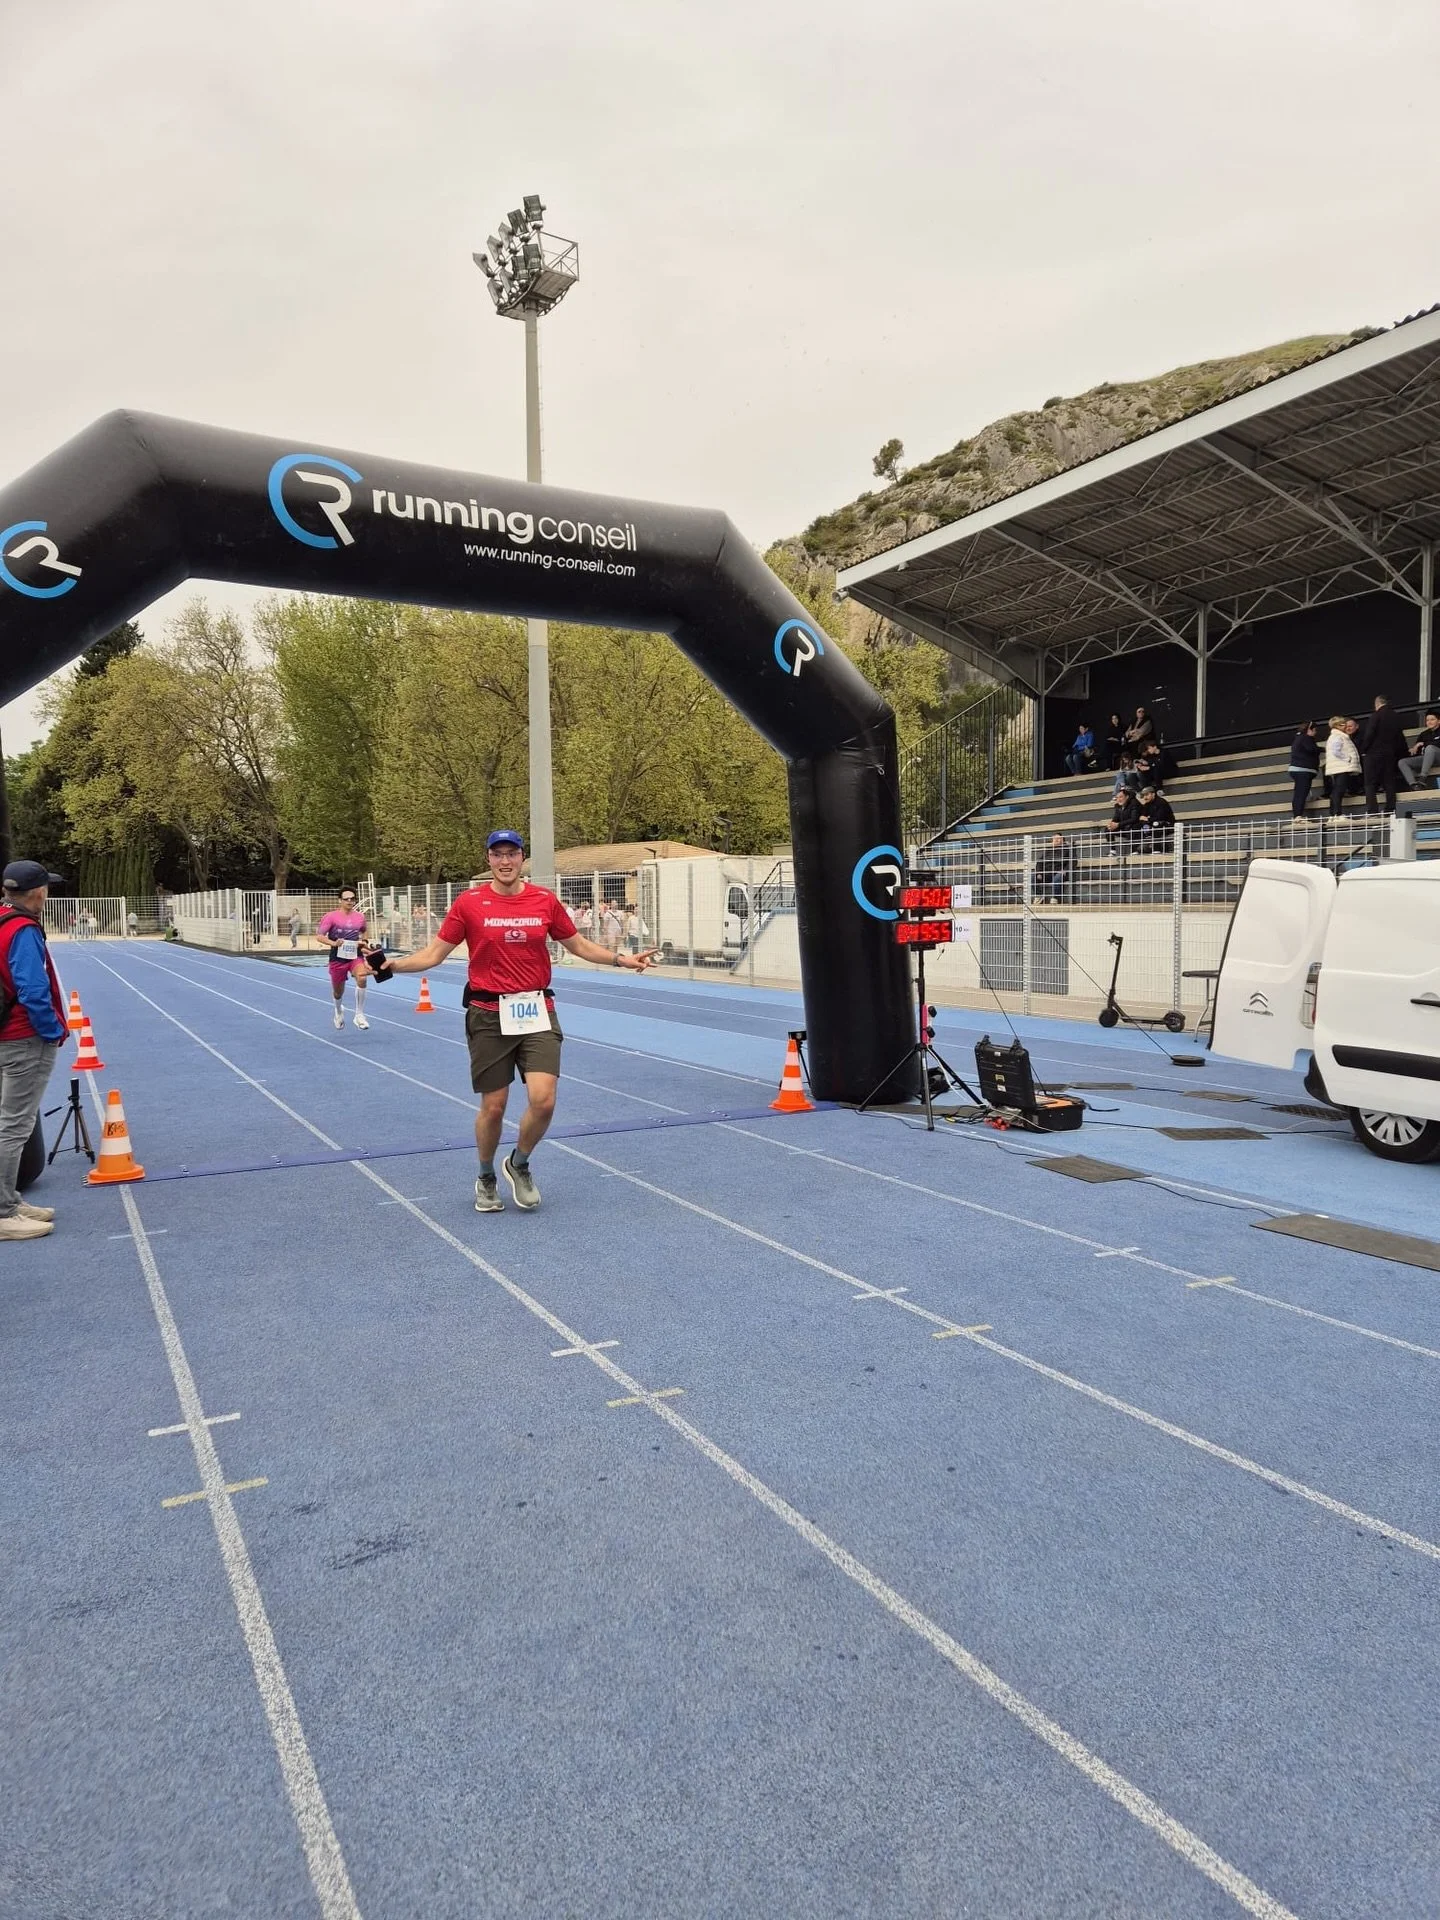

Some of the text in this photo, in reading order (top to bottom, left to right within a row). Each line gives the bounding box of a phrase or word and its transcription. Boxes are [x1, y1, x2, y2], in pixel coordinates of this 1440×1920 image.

[464, 543, 636, 577] www.running-conseil.com
[484, 917, 542, 927] MONACORUN
[509, 1002, 539, 1018] 1044
